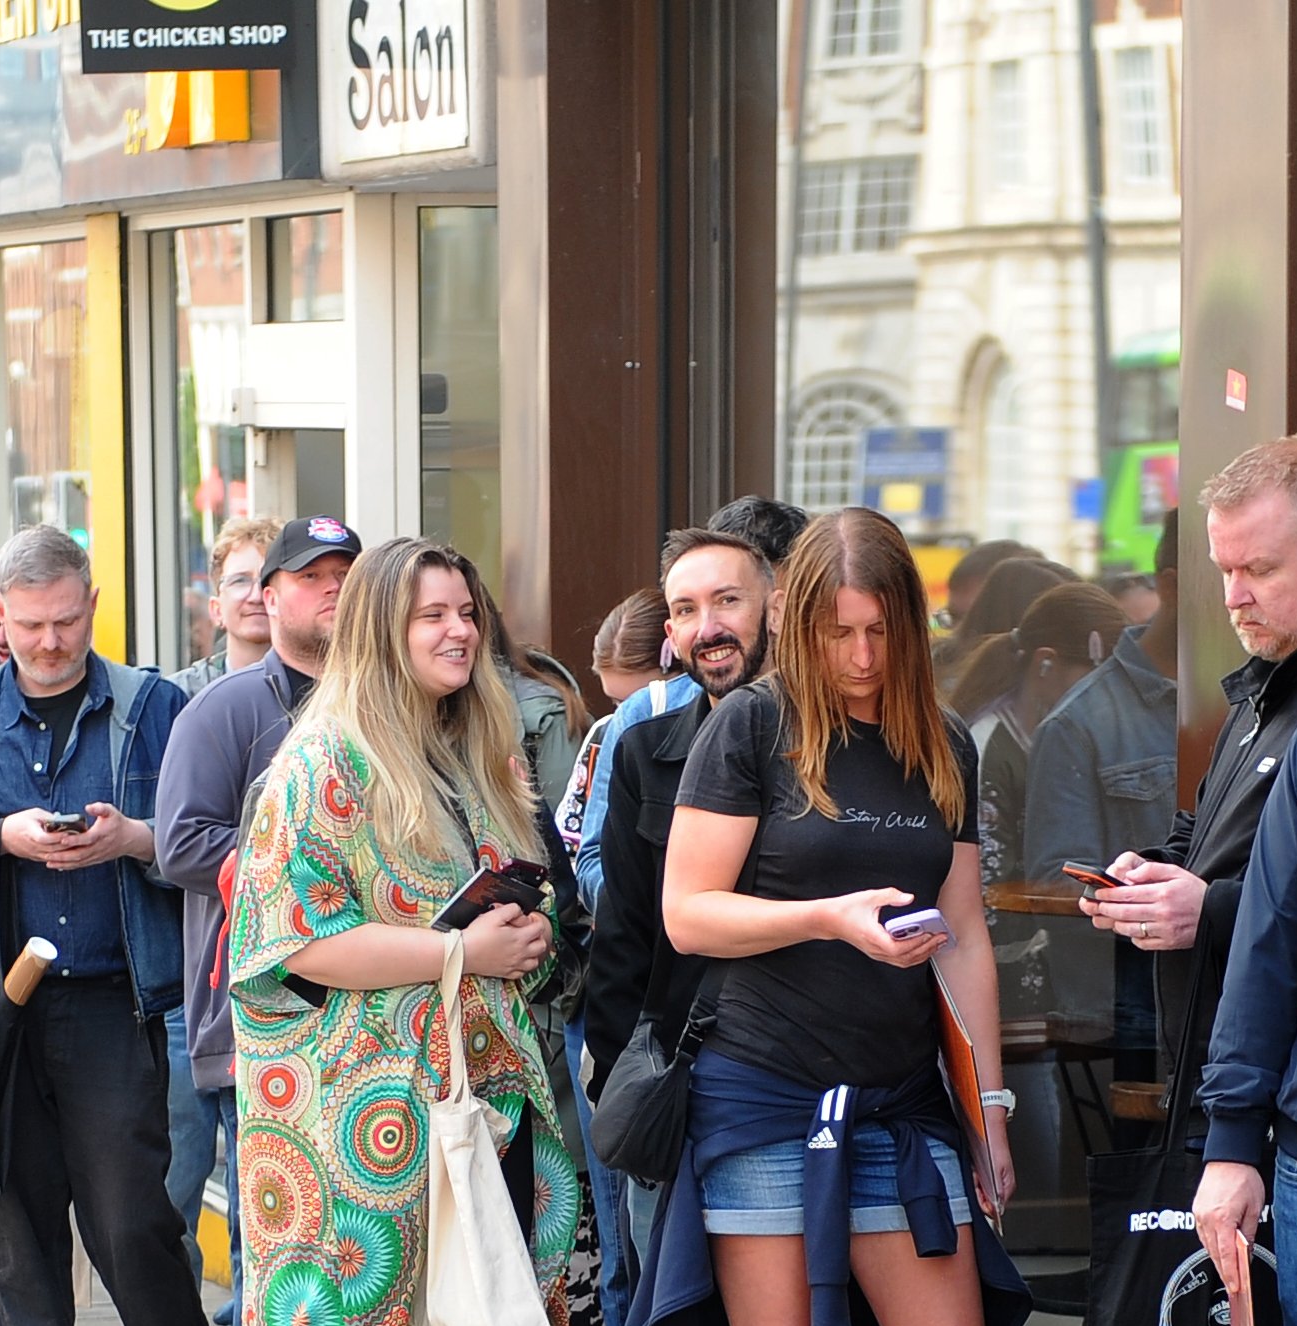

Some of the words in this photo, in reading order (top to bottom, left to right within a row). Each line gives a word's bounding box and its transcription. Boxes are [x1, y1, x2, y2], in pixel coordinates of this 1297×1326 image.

[87, 28, 130, 49] THE
[133, 26, 225, 48] CHICKEN
[229, 24, 287, 45] SHOP
[348, 0, 456, 131] Salon
[835, 807, 881, 832] Stay
[885, 811, 928, 829] Wild
[1129, 1209, 1195, 1232] RECORD
